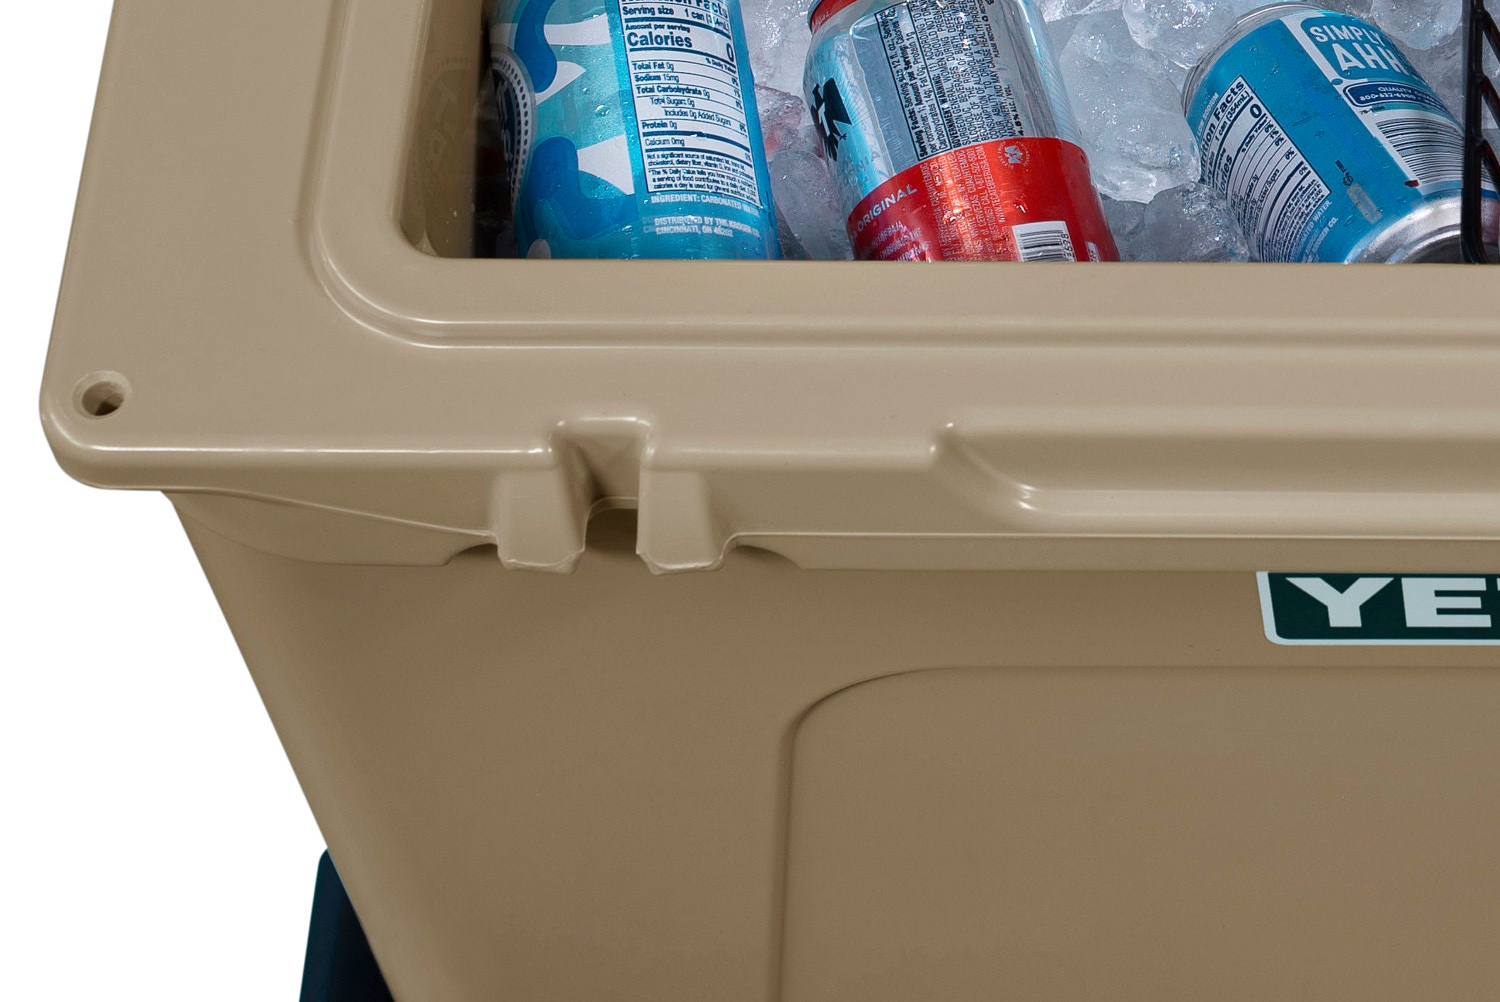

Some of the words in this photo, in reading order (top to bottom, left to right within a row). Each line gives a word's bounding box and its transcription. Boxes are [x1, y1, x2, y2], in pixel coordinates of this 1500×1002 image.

[622, 5, 655, 16] Serving
[657, 5, 674, 16] size
[692, 11, 704, 20] can
[1310, 25, 1385, 47] SIMPLY
[627, 31, 693, 48] Calories
[726, 42, 734, 62] 0
[632, 62, 651, 70] Total
[653, 62, 665, 70] Fat
[635, 74, 661, 82] Sodium
[663, 74, 679, 84] 15mg
[636, 86, 655, 94] Total
[657, 86, 702, 95] Carbohydrate
[650, 97, 665, 105] Total
[666, 97, 686, 106] Sugars
[1214, 81, 1245, 122] Facts
[664, 109, 689, 117] Includes
[697, 111, 714, 120] Added
[715, 114, 732, 126] Sugars
[1218, 120, 1228, 136] can
[1225, 90, 1250, 122] (354mL)
[1249, 103, 1262, 118] 0
[642, 121, 668, 129] Protein
[645, 138, 670, 146] Calcium
[858, 183, 918, 230] ORIGINAL
